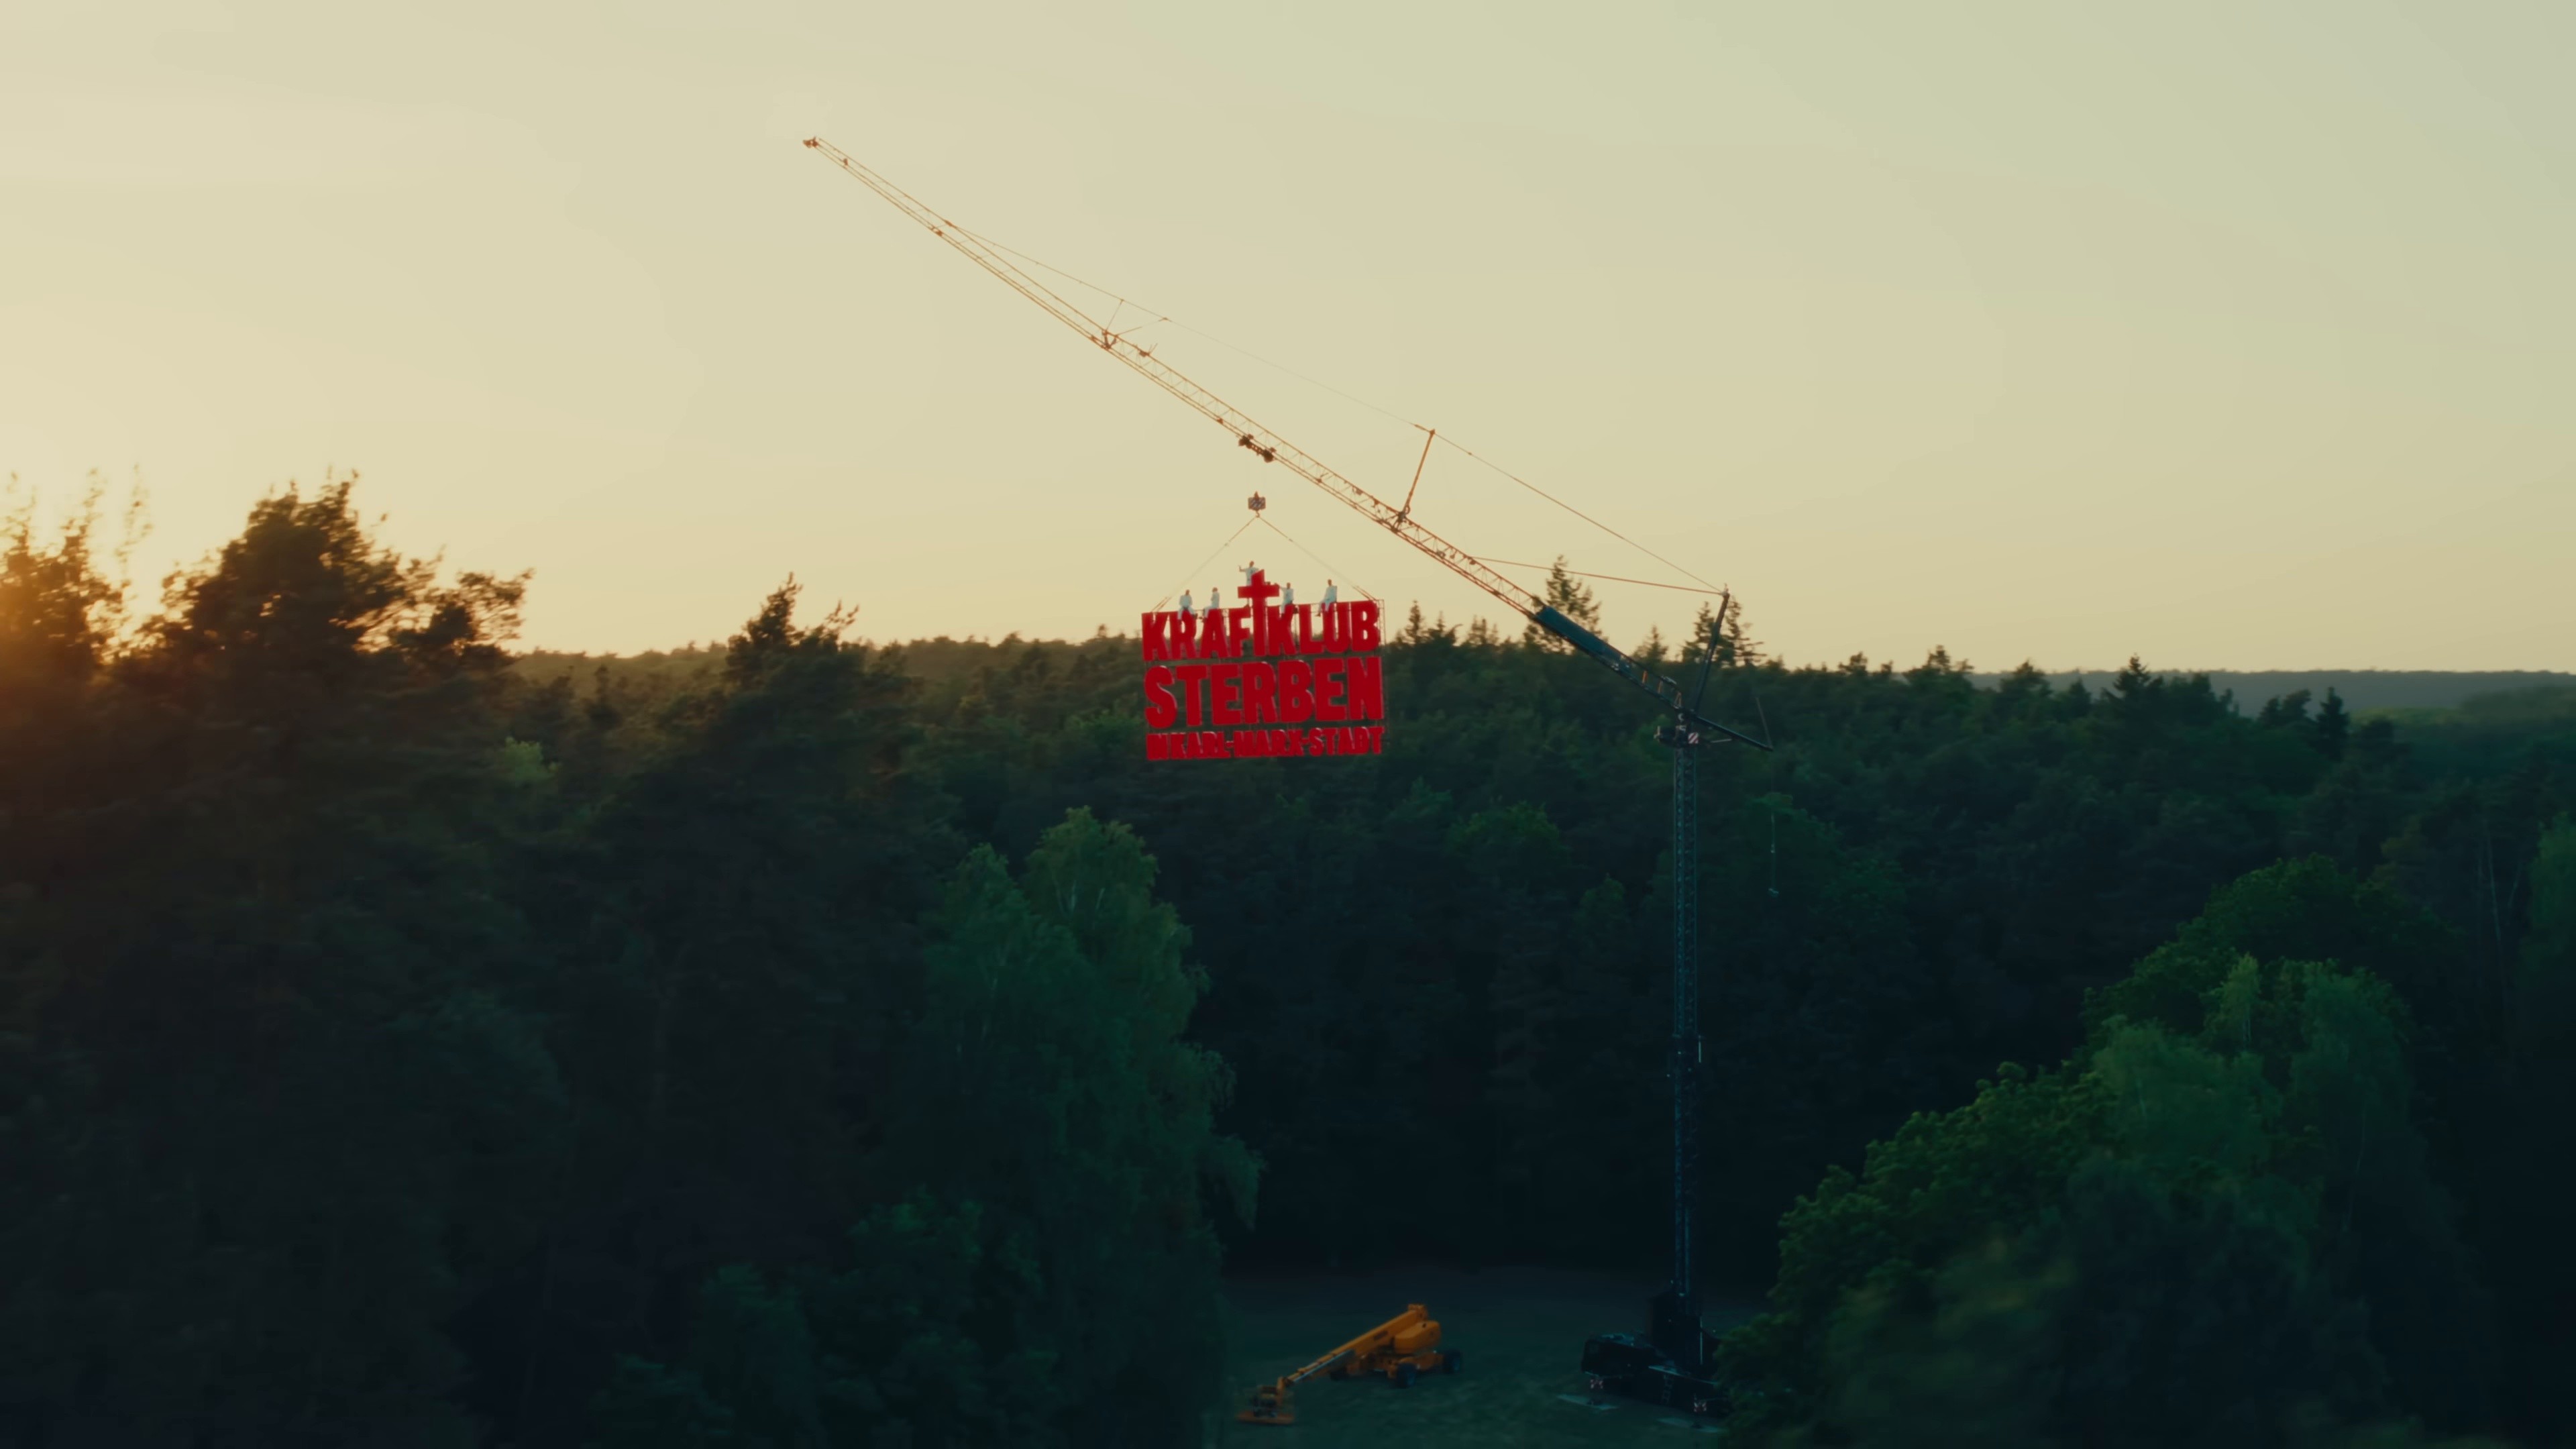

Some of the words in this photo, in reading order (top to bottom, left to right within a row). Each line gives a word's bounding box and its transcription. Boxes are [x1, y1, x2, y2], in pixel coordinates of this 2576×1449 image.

[1141, 569, 1380, 661] KRAFTKLUB
[1144, 656, 1384, 729] STERBEN
[1146, 732, 1169, 761] IN
[1170, 726, 1385, 759] KARL-MARX-STADT
